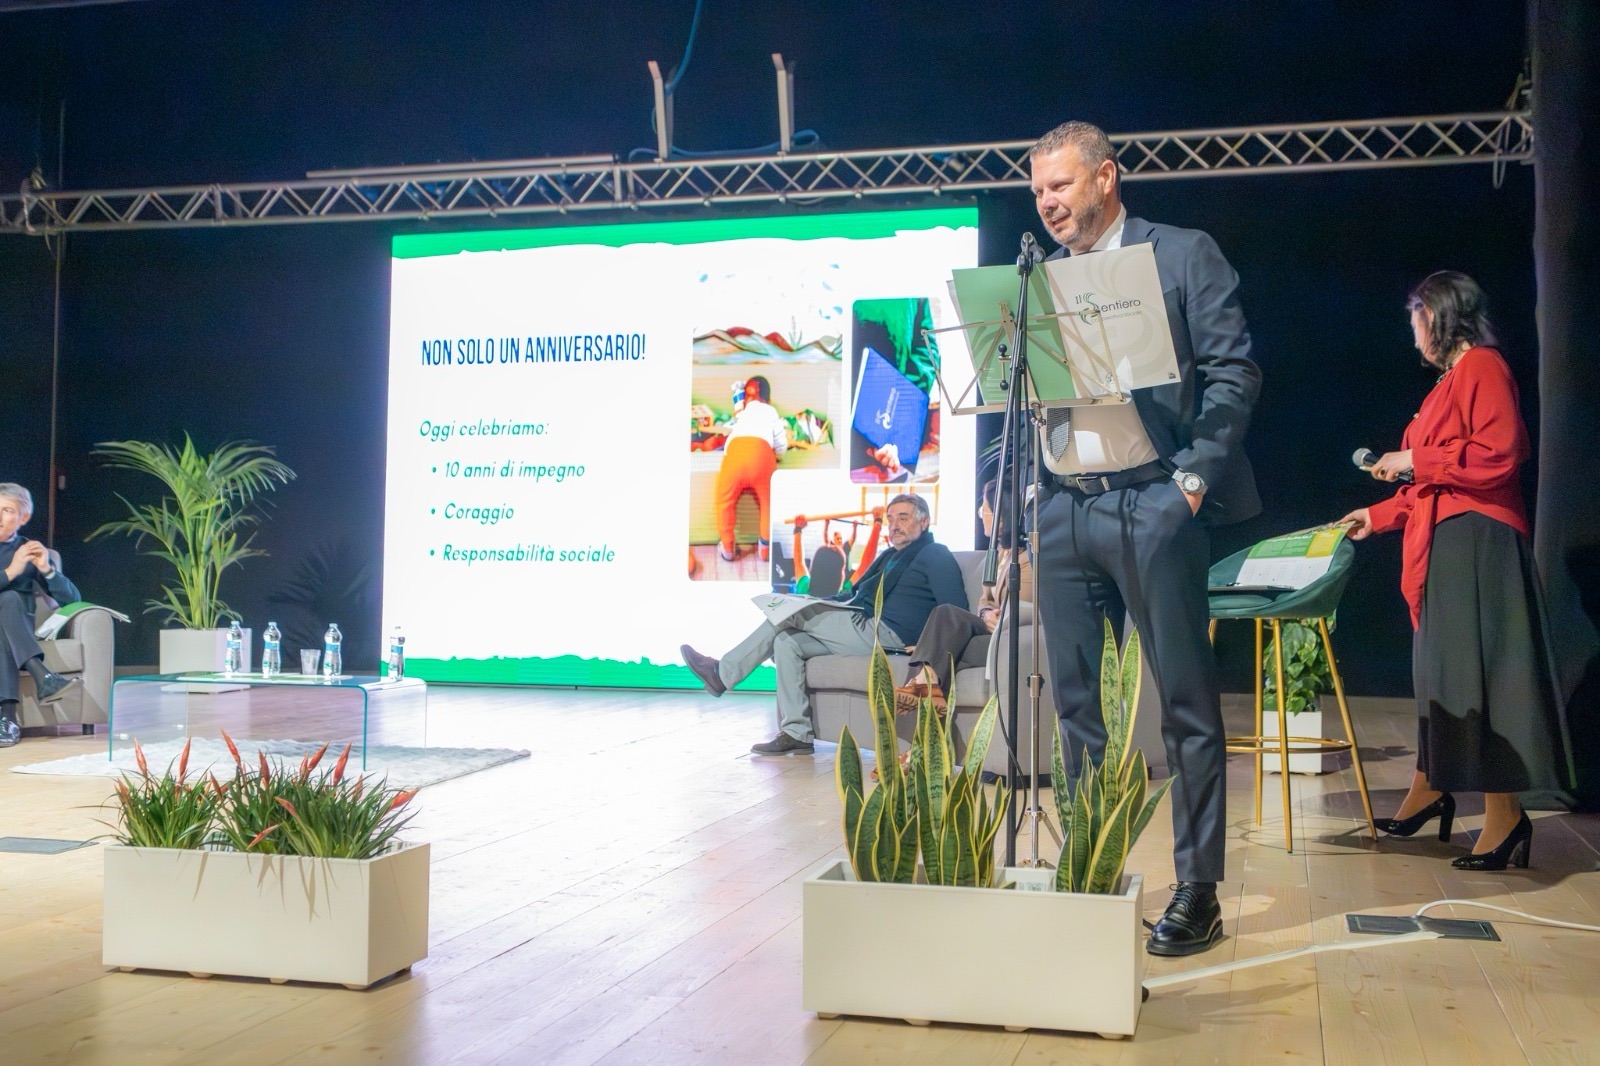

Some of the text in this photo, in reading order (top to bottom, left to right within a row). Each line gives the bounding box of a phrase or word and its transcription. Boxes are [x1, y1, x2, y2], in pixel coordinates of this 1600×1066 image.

[421, 333, 646, 366] NON SOLO UN ANNIVERSARIO!
[419, 418, 550, 442] Oggi celebriamo:
[445, 459, 586, 483] 10 anni di impegno
[444, 502, 515, 525] Coraggio
[442, 543, 616, 567] Responsabilità sociale
